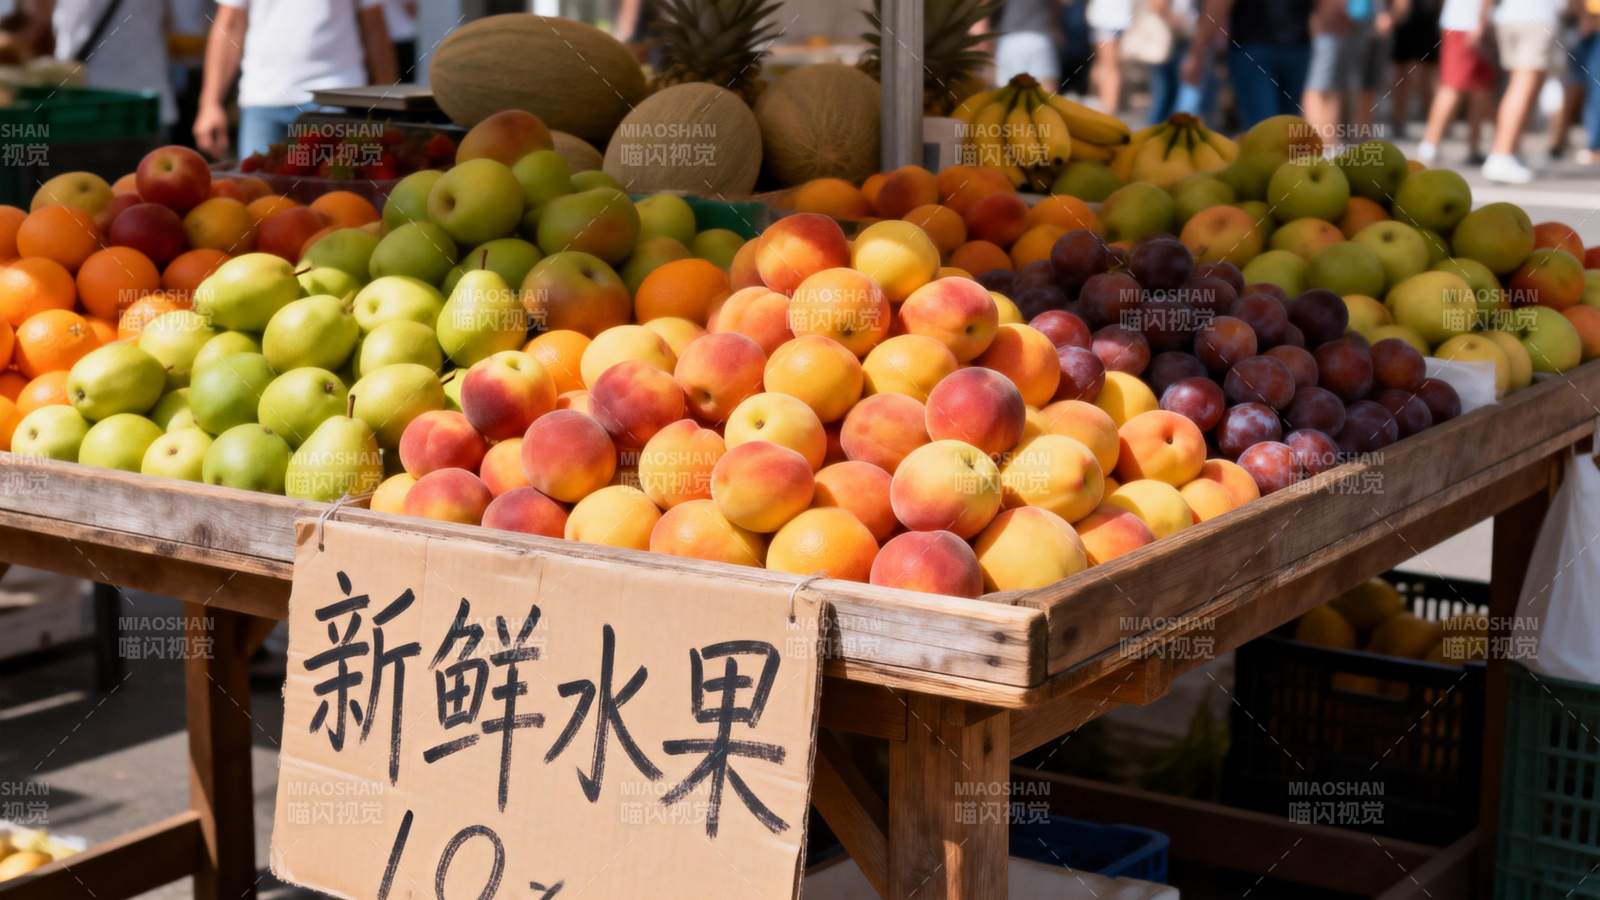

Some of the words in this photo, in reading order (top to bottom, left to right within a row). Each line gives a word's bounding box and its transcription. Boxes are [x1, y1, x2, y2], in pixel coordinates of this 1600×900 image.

[303, 571, 790, 838] 新鲜水果
[376, 809, 564, 900] 10
